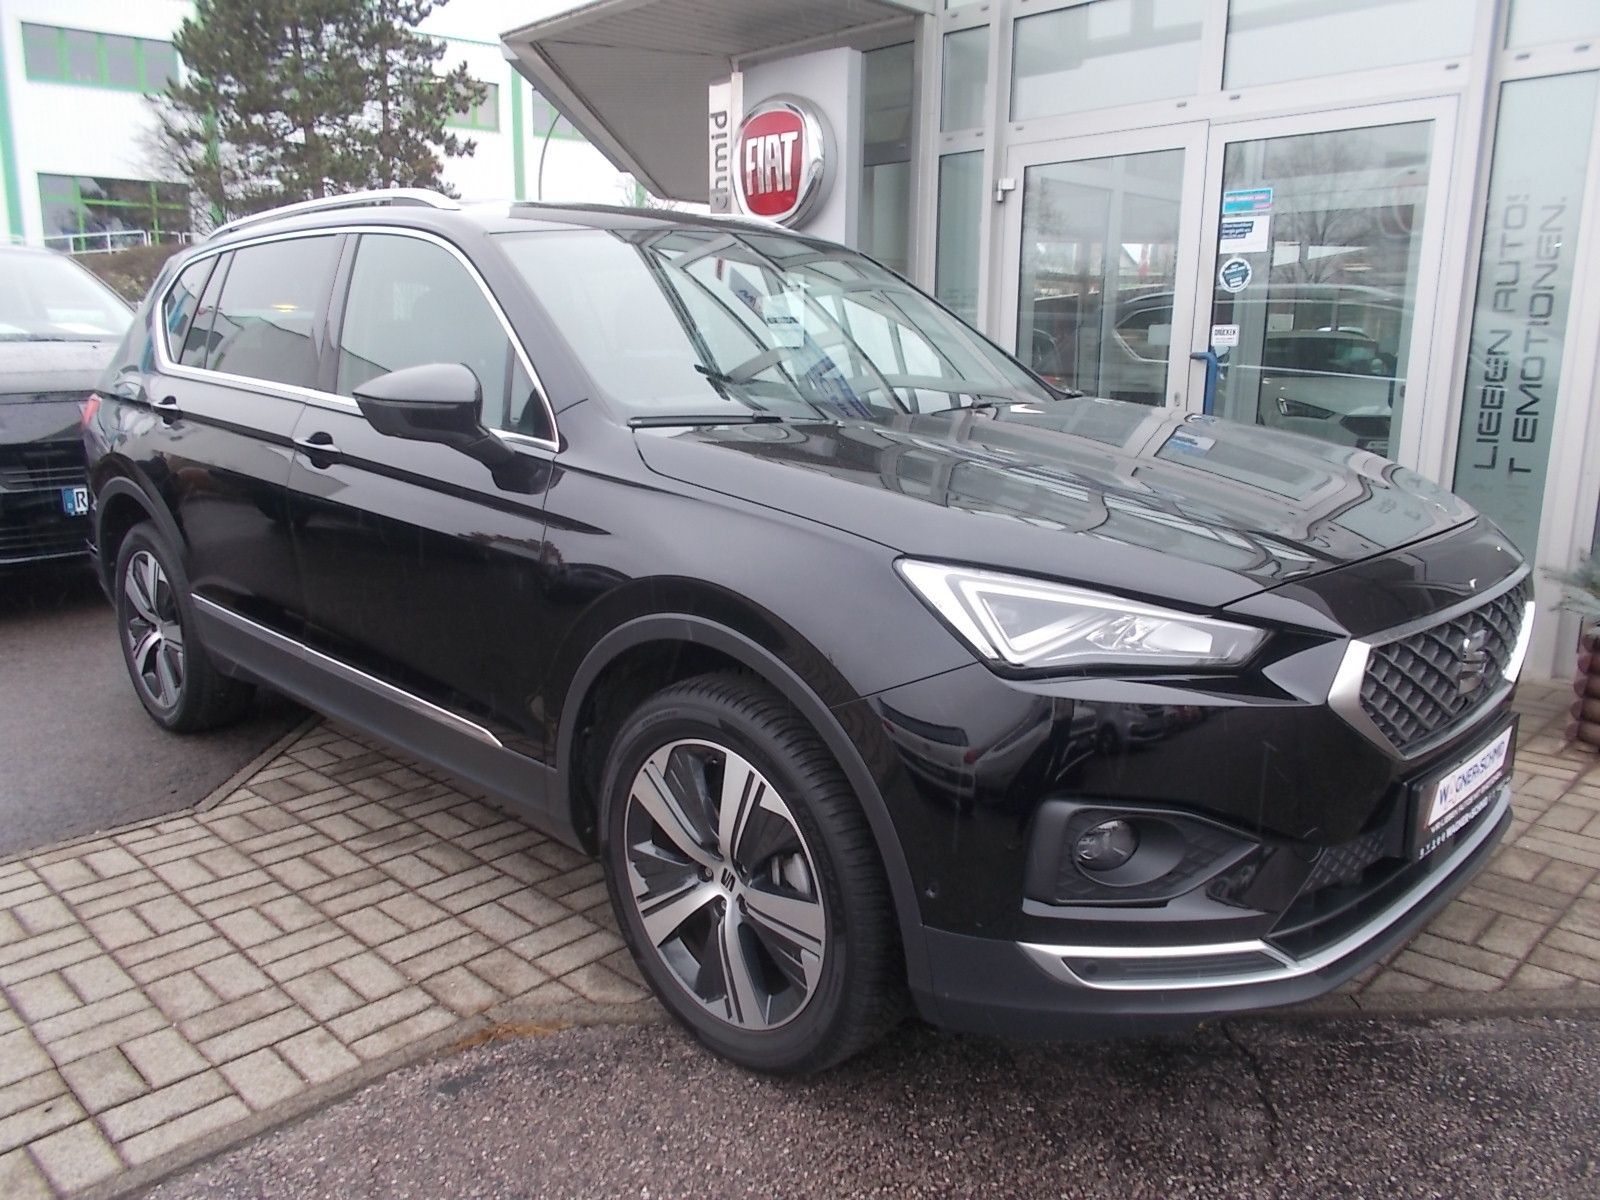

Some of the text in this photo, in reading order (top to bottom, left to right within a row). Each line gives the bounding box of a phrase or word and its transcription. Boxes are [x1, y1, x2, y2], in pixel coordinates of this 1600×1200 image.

[746, 131, 798, 195] FIAT
[1512, 196, 1567, 443] EMOTIONEN.
[1473, 329, 1512, 469] LIEBEN
[76, 491, 87, 508] R
